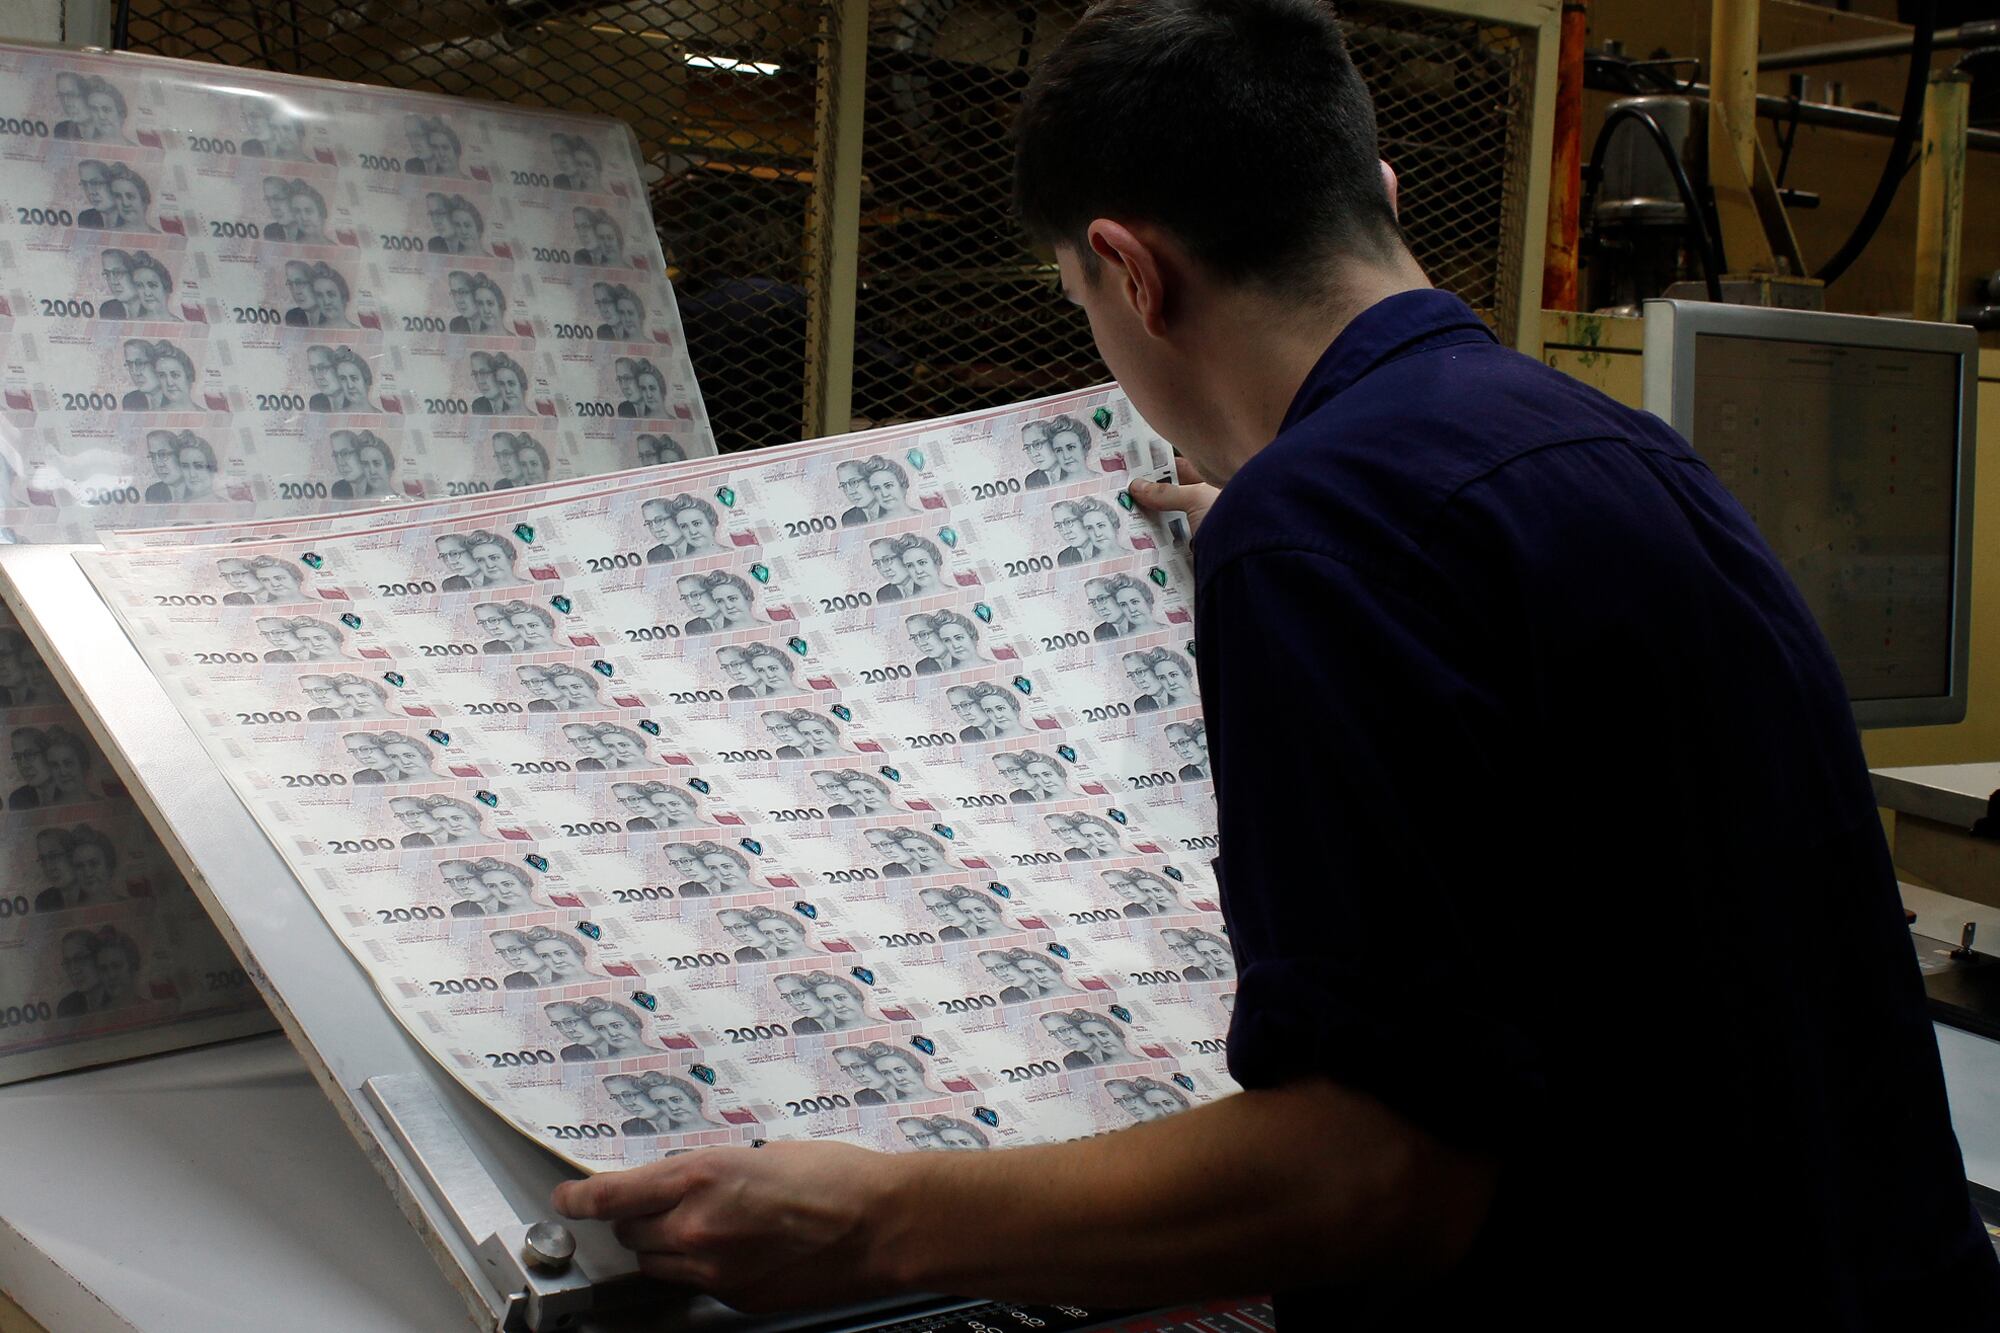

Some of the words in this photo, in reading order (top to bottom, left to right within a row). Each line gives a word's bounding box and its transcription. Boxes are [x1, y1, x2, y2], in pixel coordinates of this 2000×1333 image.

[0, 118, 48, 138] 2000
[188, 136, 237, 155] 2000
[359, 154, 401, 173] 2000
[511, 171, 550, 188] 2000
[18, 208, 73, 227] 2000
[210, 221, 259, 239] 2000
[381, 235, 424, 252] 2000
[533, 247, 571, 264] 2000
[40, 299, 94, 318] 2000
[233, 306, 281, 325] 2000
[402, 317, 446, 333] 2000
[554, 324, 593, 339] 2000
[62, 392, 117, 411] 2000
[257, 394, 305, 411] 2000
[425, 399, 468, 414] 2000
[575, 402, 615, 417] 2000
[280, 482, 327, 499] 2000
[447, 482, 490, 496] 2000
[971, 478, 1020, 500] 2000
[784, 515, 837, 537] 2000
[587, 552, 642, 572] 2000
[1004, 555, 1053, 577] 2000
[378, 581, 436, 596] 2000
[154, 595, 217, 606] 2000
[820, 592, 872, 613] 2000
[625, 624, 680, 642] 2000
[1041, 631, 1090, 651] 2000
[194, 652, 258, 664] 2000
[419, 644, 478, 656] 2000
[860, 665, 911, 684] 2000
[669, 690, 724, 704] 2000
[464, 702, 523, 714] 2000
[1082, 703, 1131, 722] 2000
[236, 711, 302, 724] 2000
[905, 732, 956, 748] 2000
[718, 749, 772, 762] 2000
[511, 761, 571, 774] 2000
[281, 774, 347, 787] 2000
[1128, 771, 1176, 789] 2000
[956, 794, 1007, 808] 2000
[769, 808, 824, 822] 2000
[561, 821, 622, 836] 2000
[328, 838, 395, 854] 2000
[1011, 852, 1062, 865] 2000
[823, 868, 879, 883] 2000
[612, 886, 674, 903] 2000
[377, 906, 445, 923] 2000
[1069, 909, 1121, 924] 2000
[879, 932, 936, 947] 2000
[667, 952, 730, 970] 2000
[429, 977, 498, 994] 2000
[1130, 970, 1181, 985] 2000
[938, 995, 996, 1014] 2000
[724, 1024, 788, 1043] 2000
[1191, 1039, 1227, 1054] 200
[485, 1050, 555, 1067] 2000
[1001, 1060, 1060, 1082] 2000
[786, 1094, 850, 1116] 2000
[547, 1123, 616, 1139] 2000
